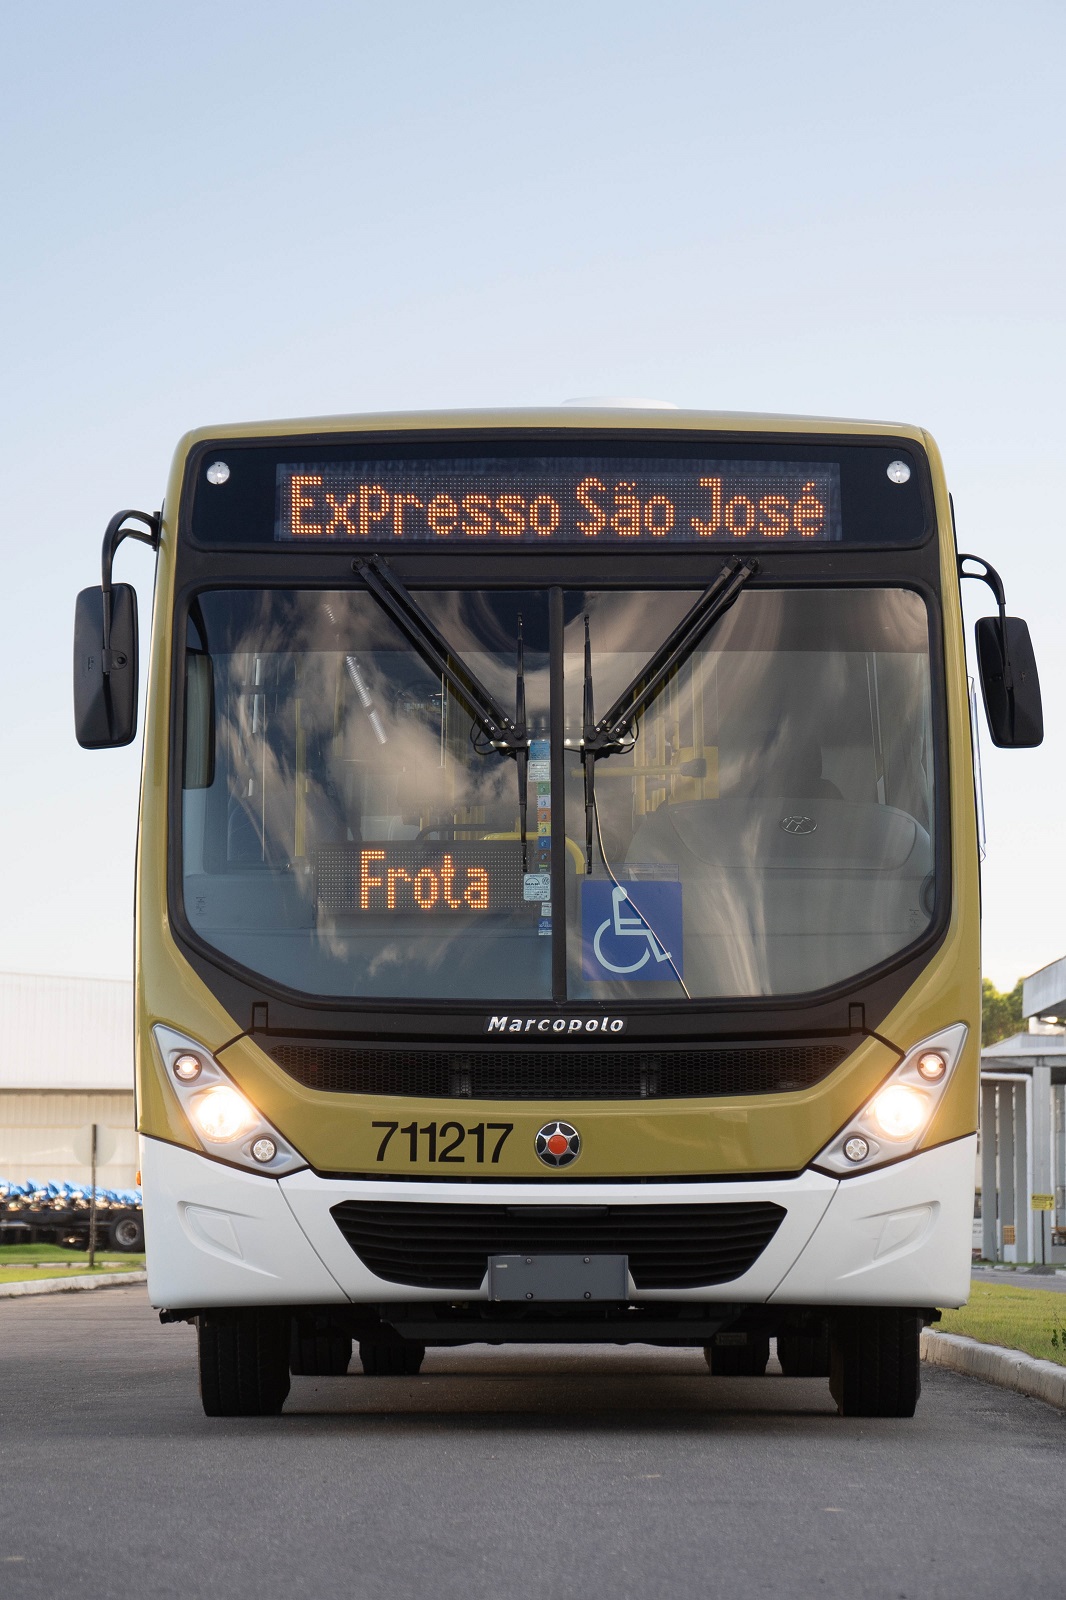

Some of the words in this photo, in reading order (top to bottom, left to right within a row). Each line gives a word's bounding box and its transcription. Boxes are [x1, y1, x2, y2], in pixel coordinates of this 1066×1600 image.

[575, 476, 675, 537] São
[690, 477, 825, 537] José
[360, 849, 489, 910] Frota
[487, 1015, 625, 1034] Marcopolo
[371, 1121, 514, 1164] 711217
